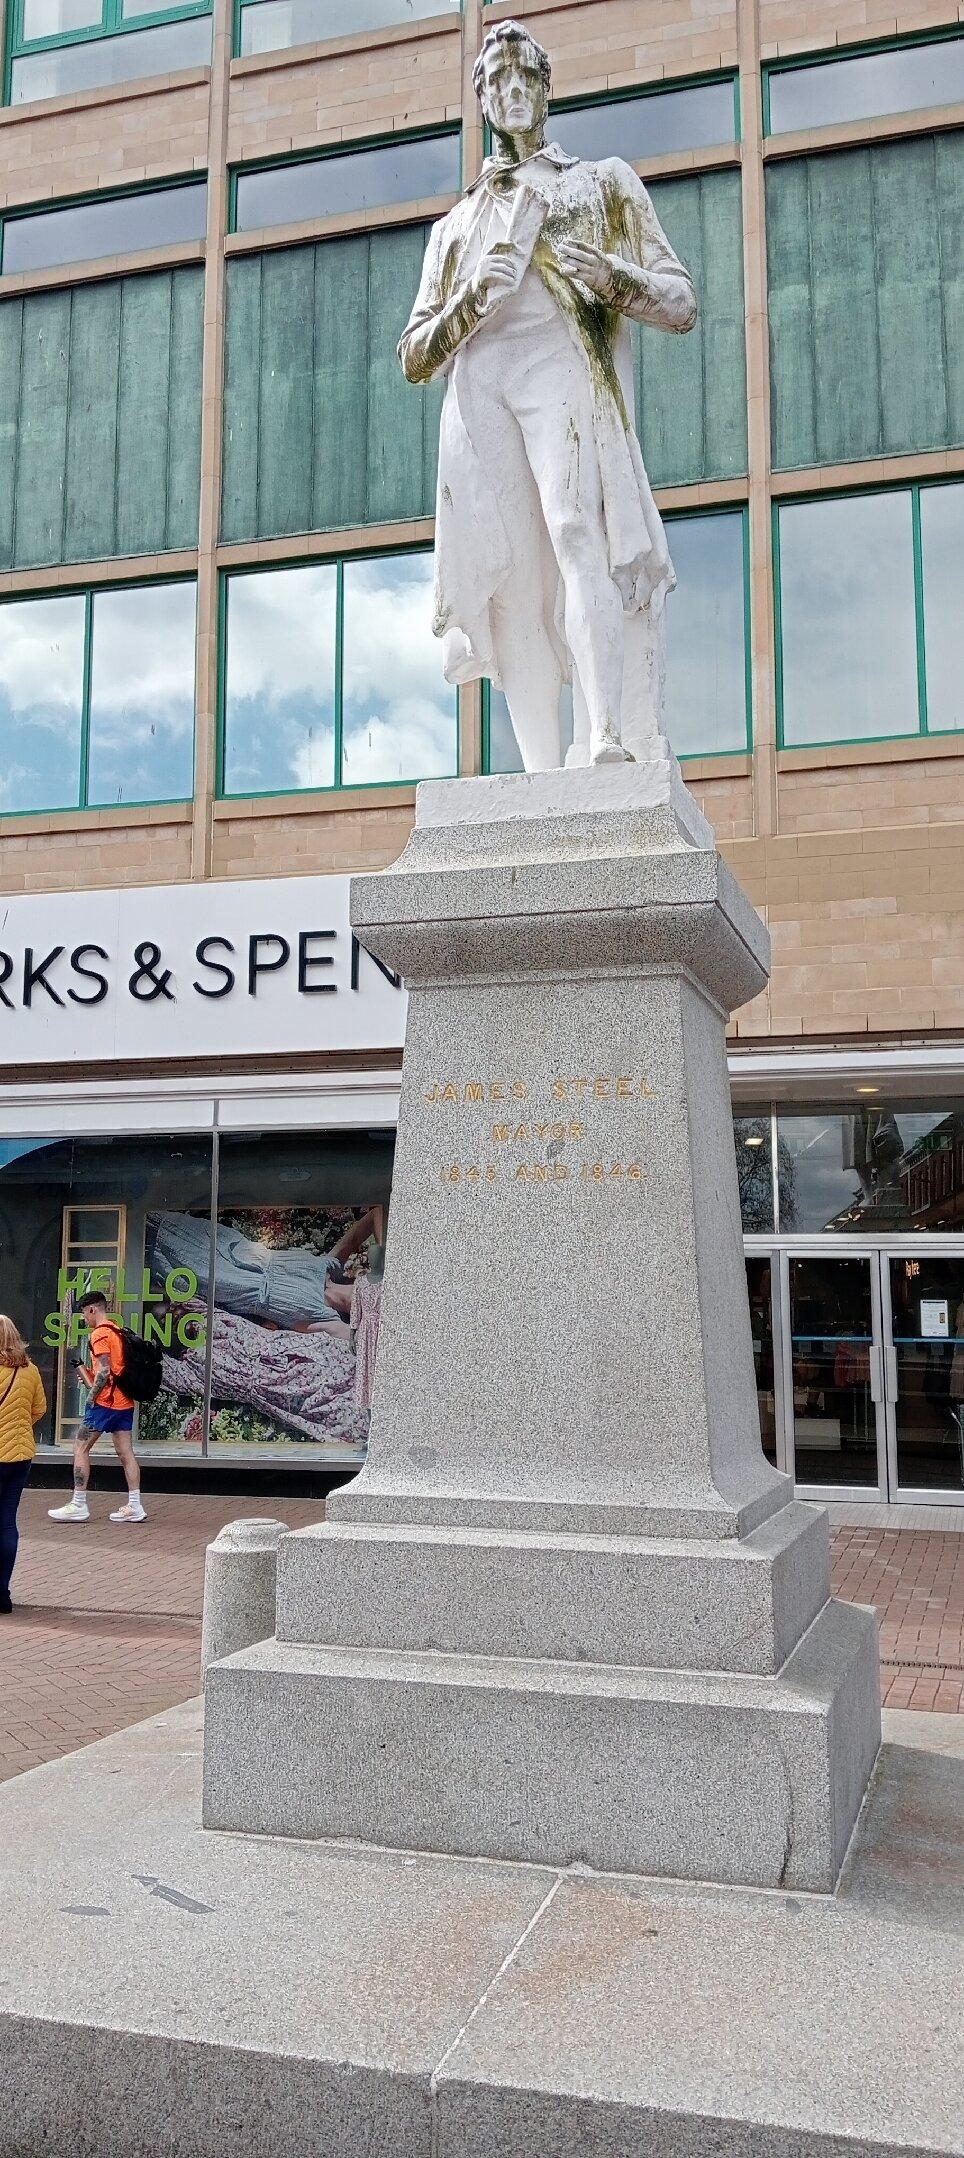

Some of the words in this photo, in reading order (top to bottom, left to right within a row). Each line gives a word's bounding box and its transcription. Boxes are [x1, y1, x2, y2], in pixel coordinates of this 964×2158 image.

[128, 940, 176, 1001] &
[424, 1081, 528, 1104] JAMES
[551, 1077, 657, 1101] STEEL
[492, 1121, 584, 1141] MAYOR
[515, 1164, 570, 1182] AND
[57, 1267, 198, 1302] HELLO
